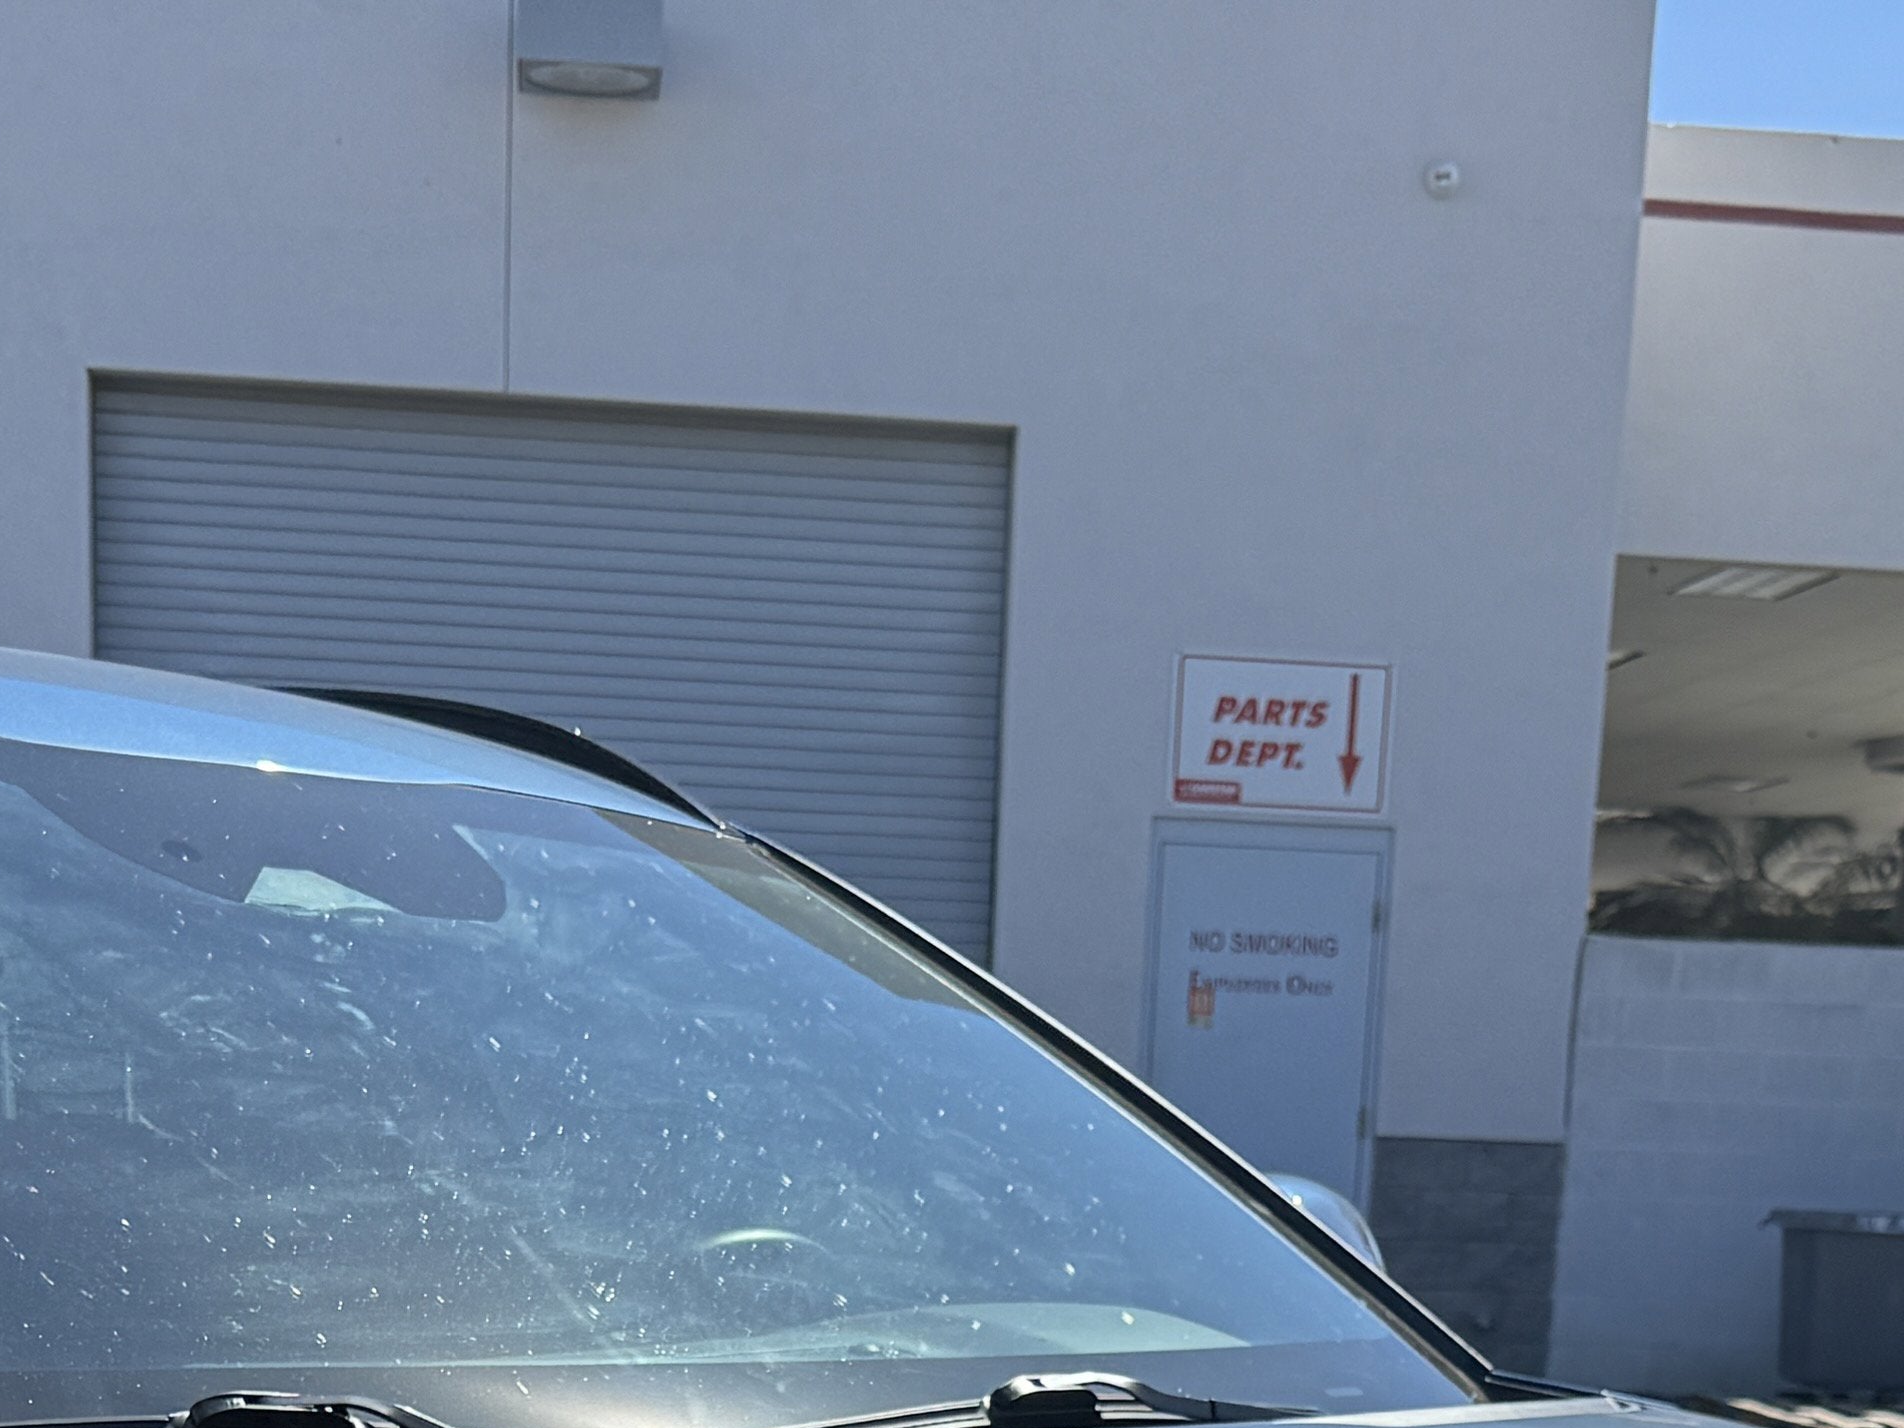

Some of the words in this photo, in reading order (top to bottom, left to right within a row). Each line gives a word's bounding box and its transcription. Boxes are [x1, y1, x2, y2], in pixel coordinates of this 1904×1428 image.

[1212, 695, 1330, 729] PARTS
[1206, 738, 1304, 770] DEPT.
[1190, 929, 1226, 953] NO
[1230, 930, 1340, 959] SMOKING
